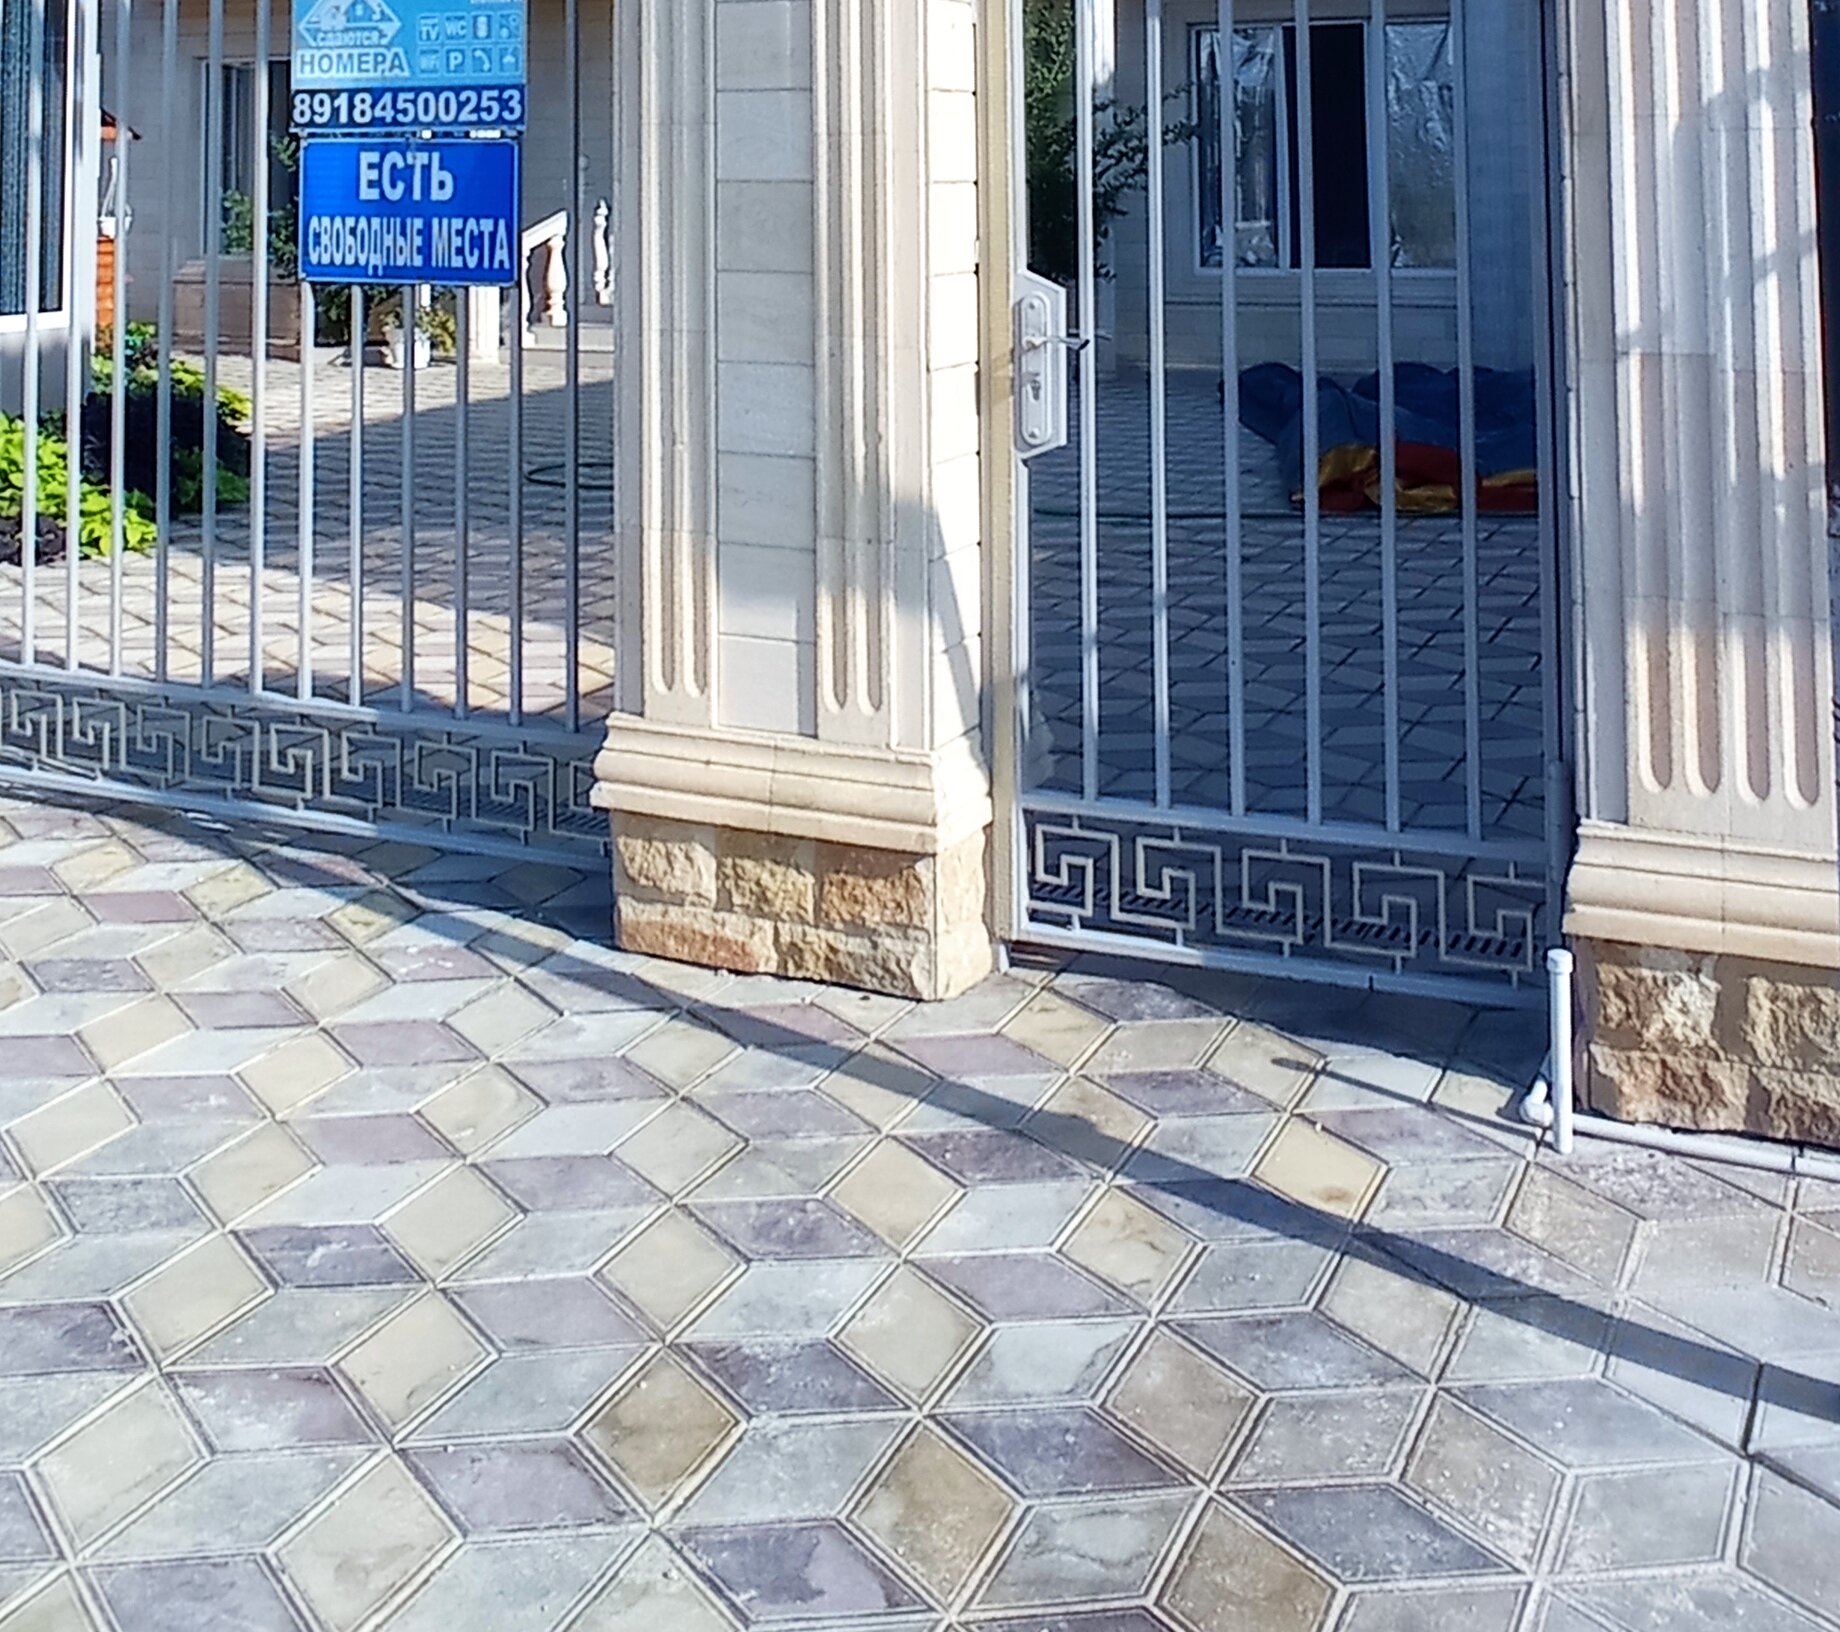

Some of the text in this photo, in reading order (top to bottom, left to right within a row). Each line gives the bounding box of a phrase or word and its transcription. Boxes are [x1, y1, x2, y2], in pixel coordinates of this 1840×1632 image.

[420, 21, 467, 41] TV WC
[300, 51, 405, 75] НОМЕРА
[292, 90, 522, 124] 89184500253
[359, 151, 454, 201] ЕСТЬ
[308, 216, 510, 276] СВОБОДНЫЕ МЕСТА
